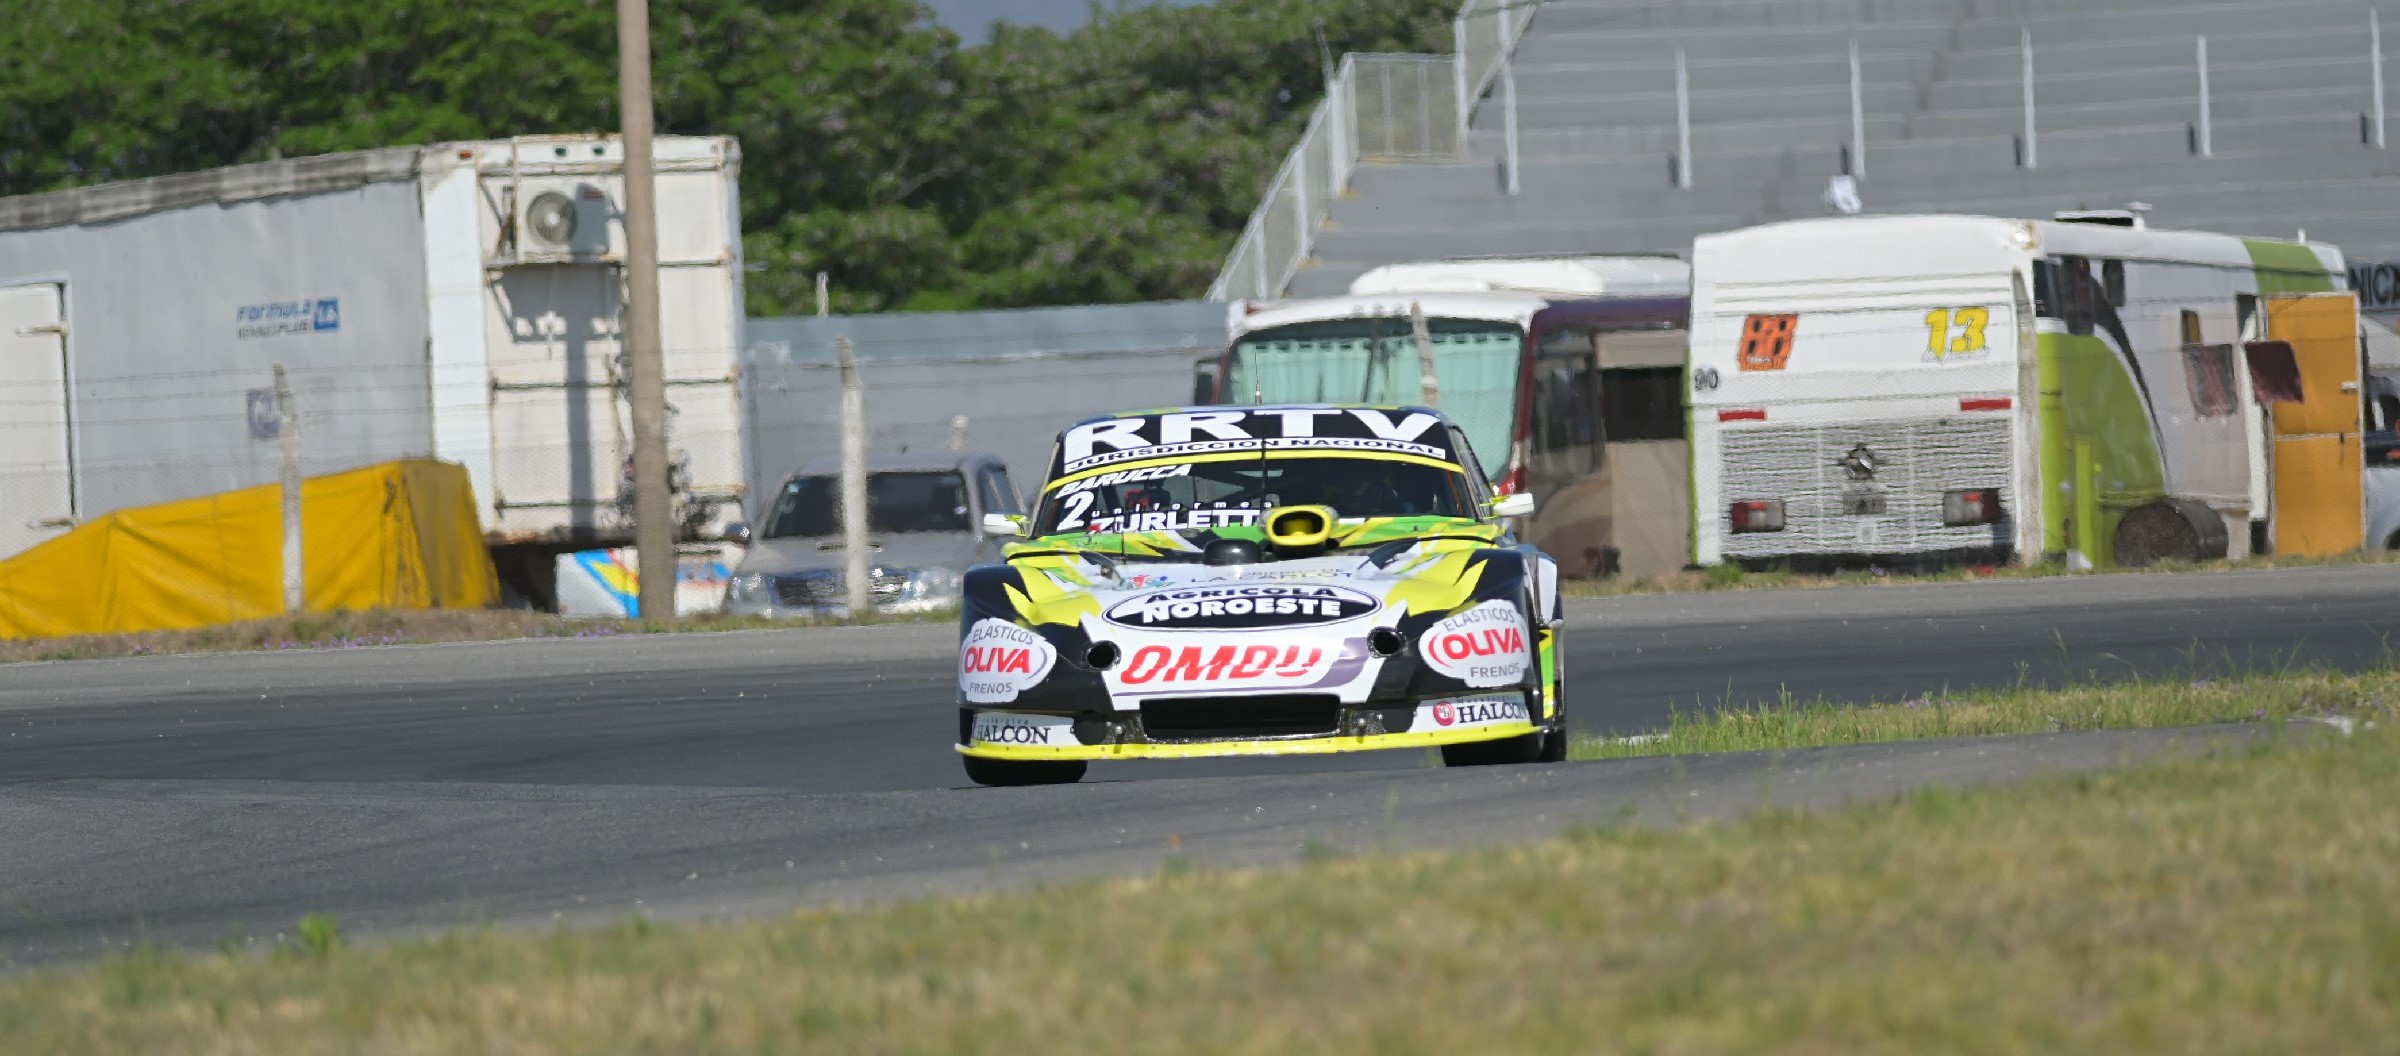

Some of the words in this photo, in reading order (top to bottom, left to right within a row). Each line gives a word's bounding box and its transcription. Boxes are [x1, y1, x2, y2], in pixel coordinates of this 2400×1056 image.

[1926, 306, 1989, 360] 13
[1064, 409, 1441, 464] RRTV
[1069, 440, 1279, 470] JURISDICCION
[1291, 439, 1442, 457] NACIONAL
[1055, 464, 1193, 499] BARUCCA
[1056, 491, 1095, 530] 2
[1091, 501, 1272, 517] uniformes
[1145, 587, 1338, 604] AGRICOLA
[1139, 598, 1341, 623] NOROESTE
[1443, 608, 1515, 632] ELASTICOS
[973, 625, 1035, 646] ELASTICOS
[1442, 628, 1525, 660] OLIVA
[964, 646, 1031, 674] OLIVA
[1470, 663, 1521, 678] FRENOS
[969, 682, 1012, 694] FRENOS
[976, 725, 1052, 745] HALCON
